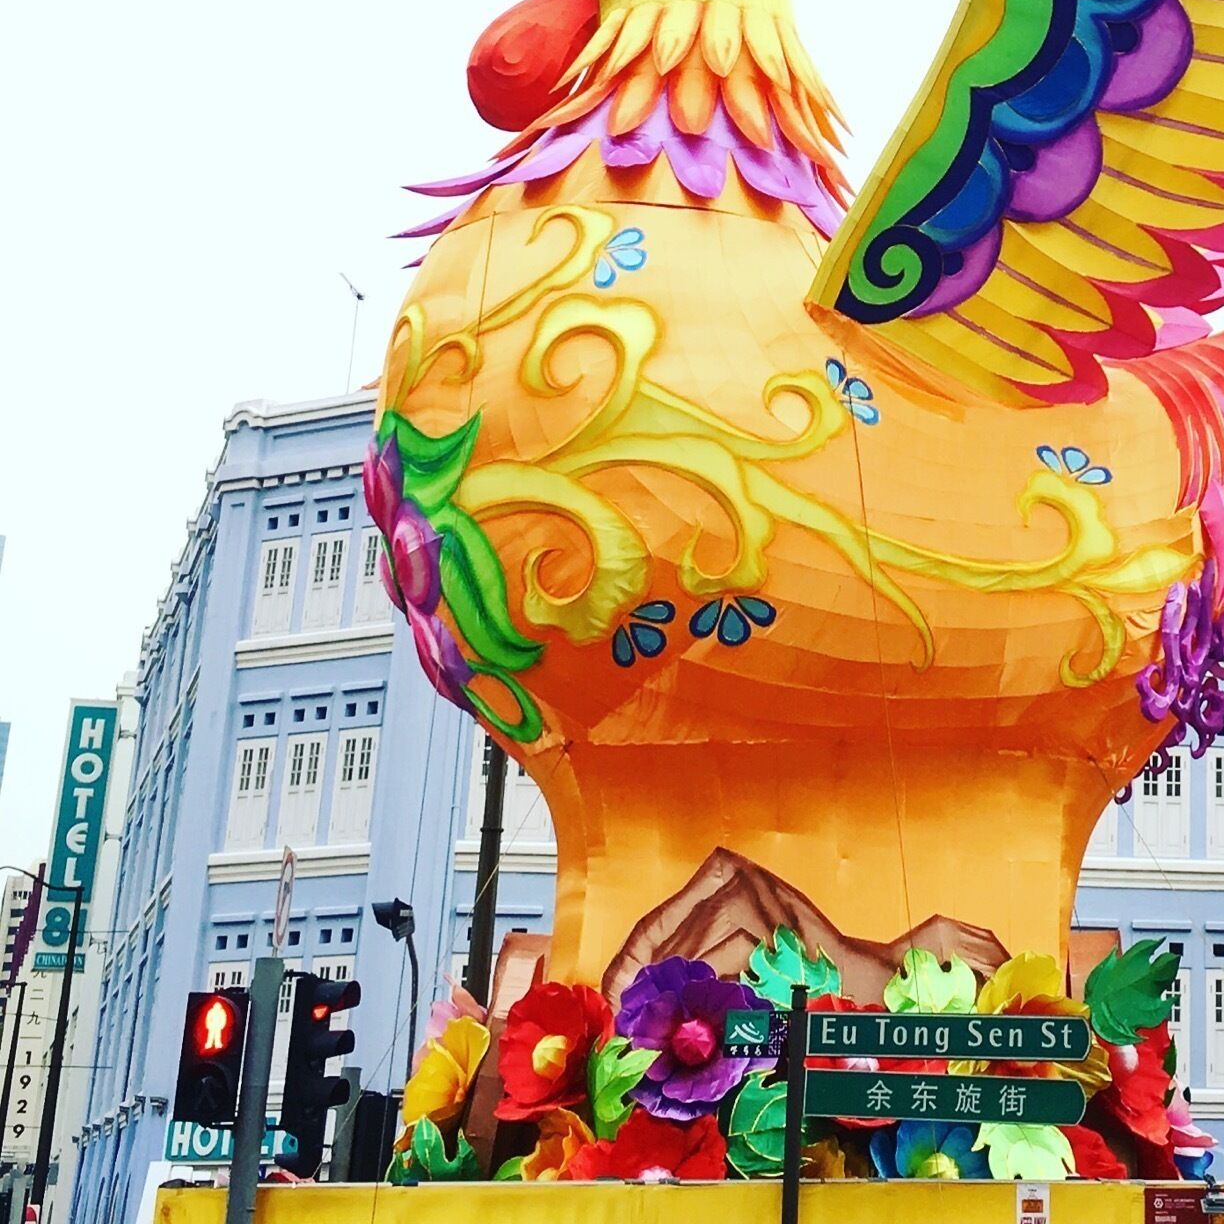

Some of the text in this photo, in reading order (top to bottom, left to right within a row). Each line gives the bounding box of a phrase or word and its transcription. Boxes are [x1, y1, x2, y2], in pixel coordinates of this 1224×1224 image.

[63, 718, 105, 888] HOTEL
[821, 1017, 1072, 1053] Eu Tong Sen St
[13, 1050, 32, 1138] 1929
[866, 1080, 1026, 1116] 余东旋街
